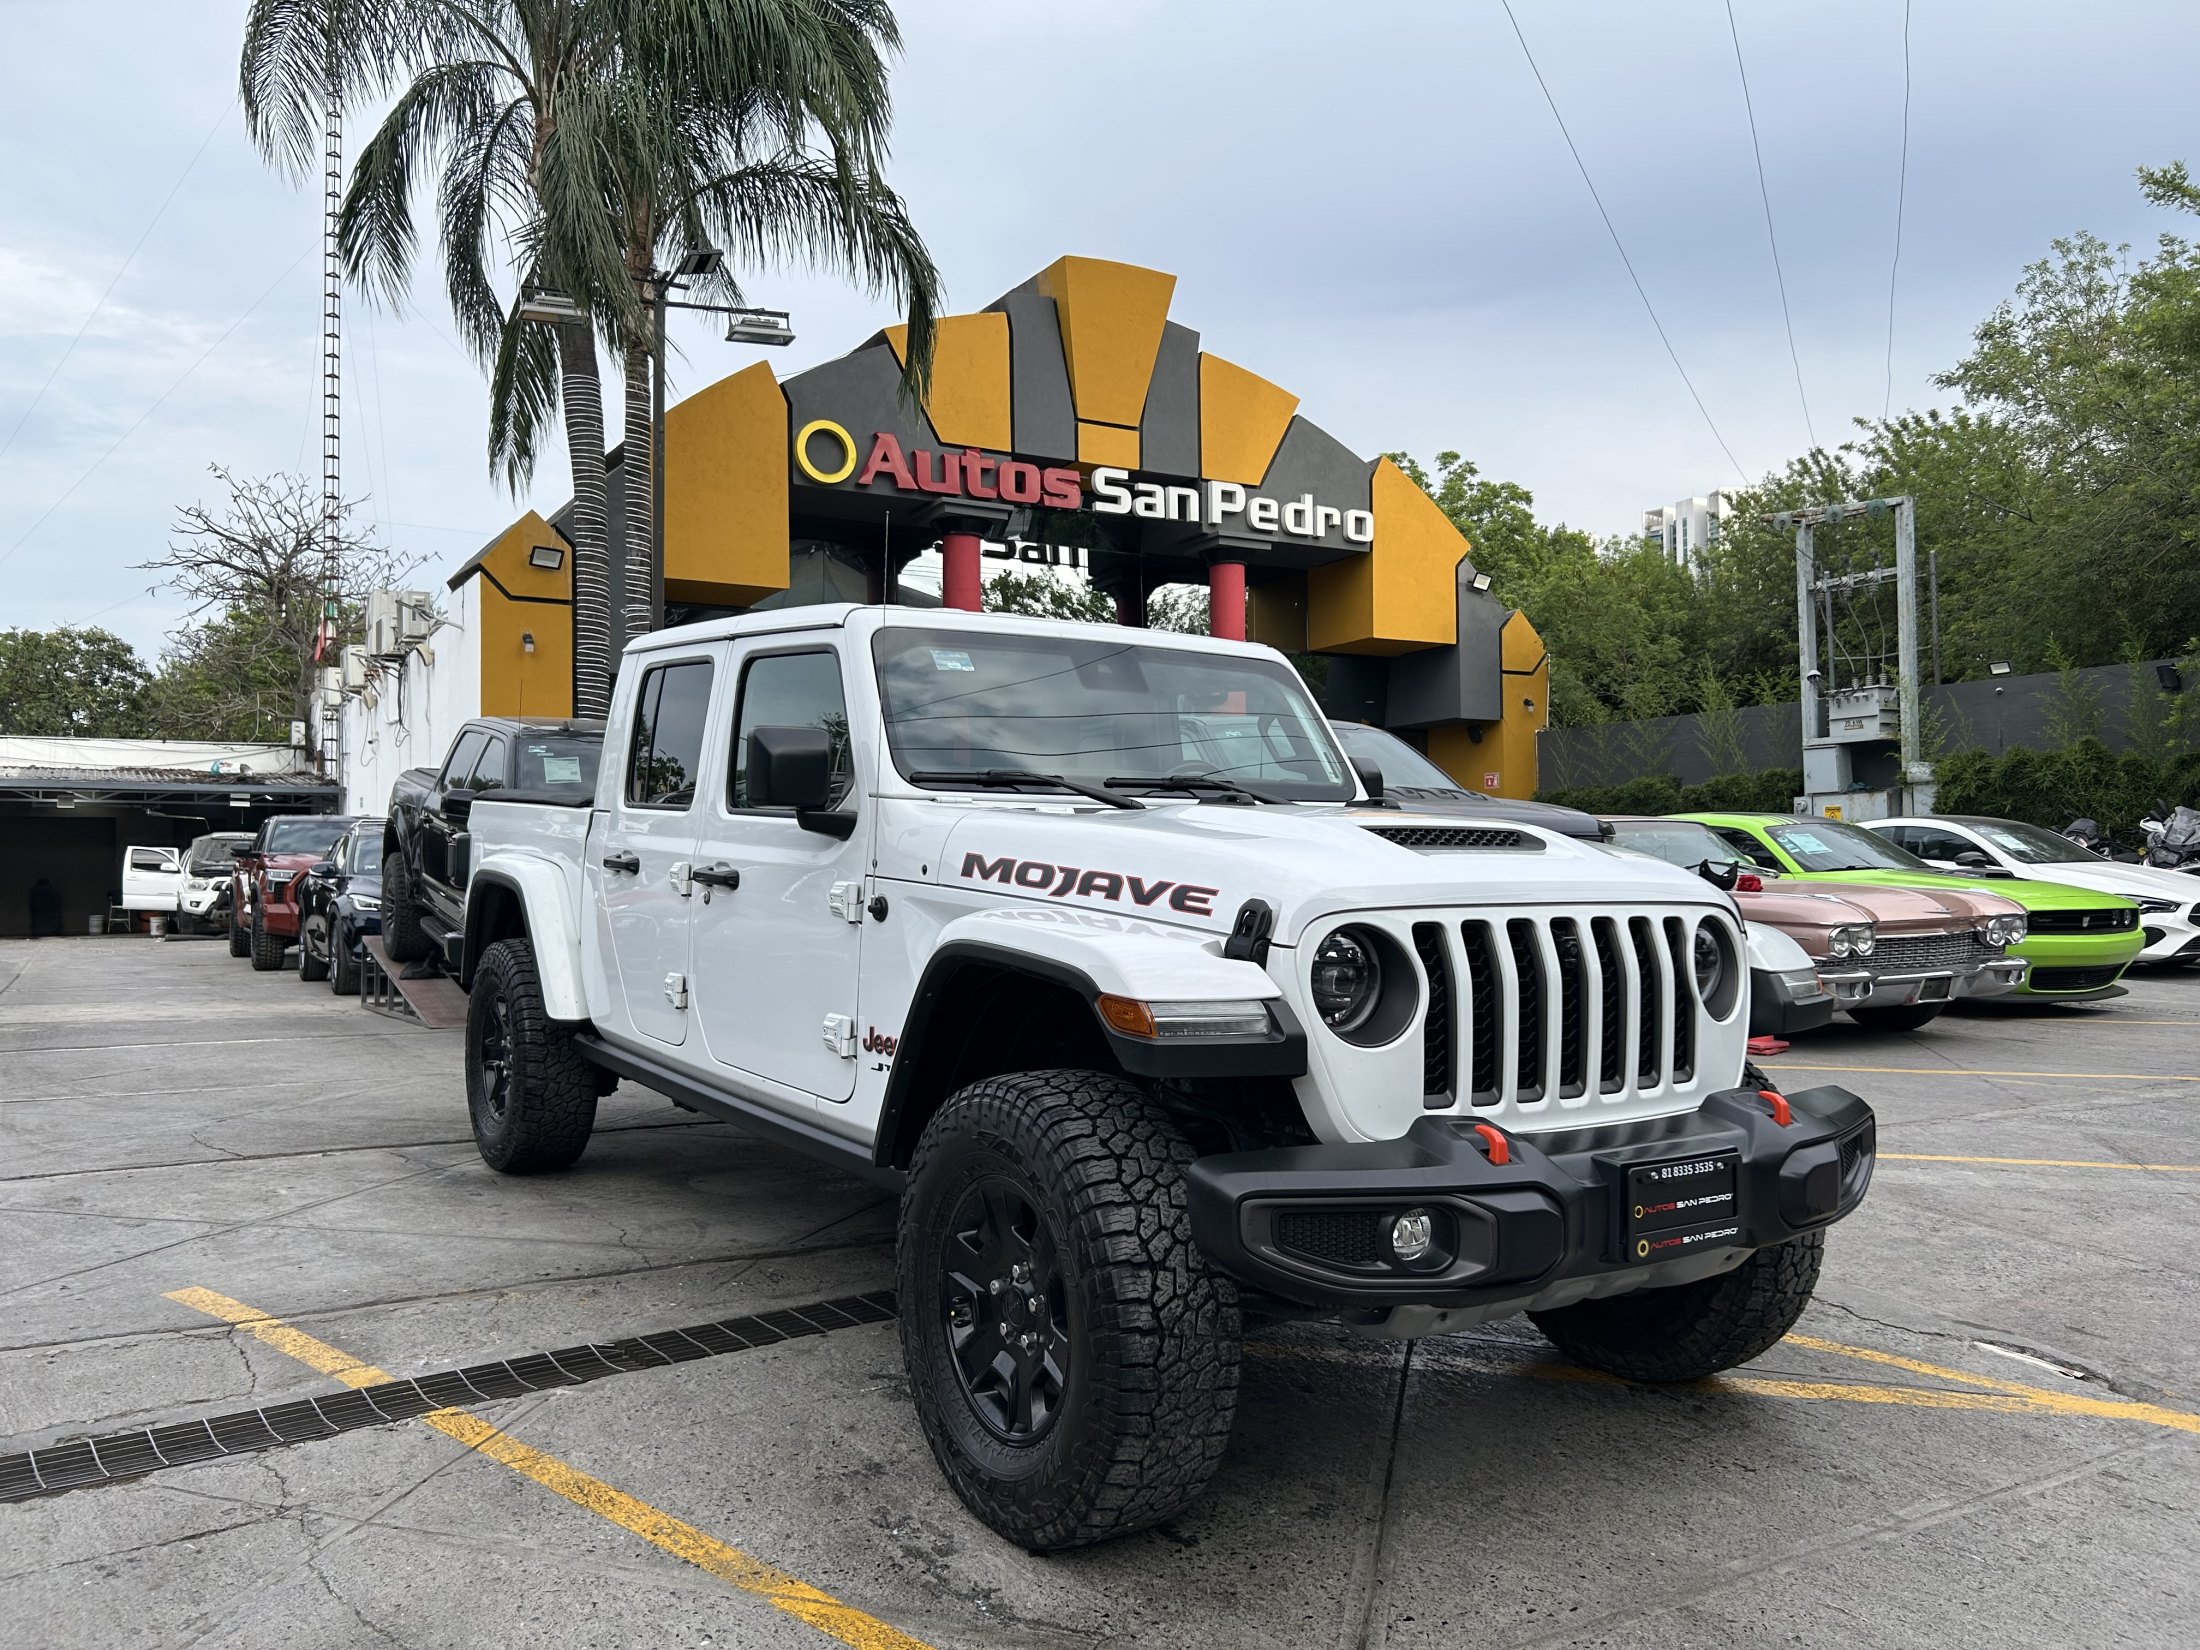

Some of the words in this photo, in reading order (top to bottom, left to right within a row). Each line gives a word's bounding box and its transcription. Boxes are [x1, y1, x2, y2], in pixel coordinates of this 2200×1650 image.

[857, 432, 1082, 509] Autos
[1091, 467, 1200, 522] San
[1207, 480, 1374, 543] Pedro
[960, 852, 1220, 917] MOJAVE
[863, 1025, 898, 1057] Jee
[1661, 1167, 1672, 1179] 81
[1673, 1164, 1694, 1177] 8335
[1694, 1161, 1714, 1174] 3535
[1644, 1202, 1676, 1214] AUTOS
[1676, 1199, 1698, 1209] SAN
[1698, 1193, 1732, 1205] PEDRO
[1650, 1238, 1682, 1249] AUTOS
[1682, 1234, 1704, 1244] SAN
[1704, 1227, 1737, 1239] PEDRO
